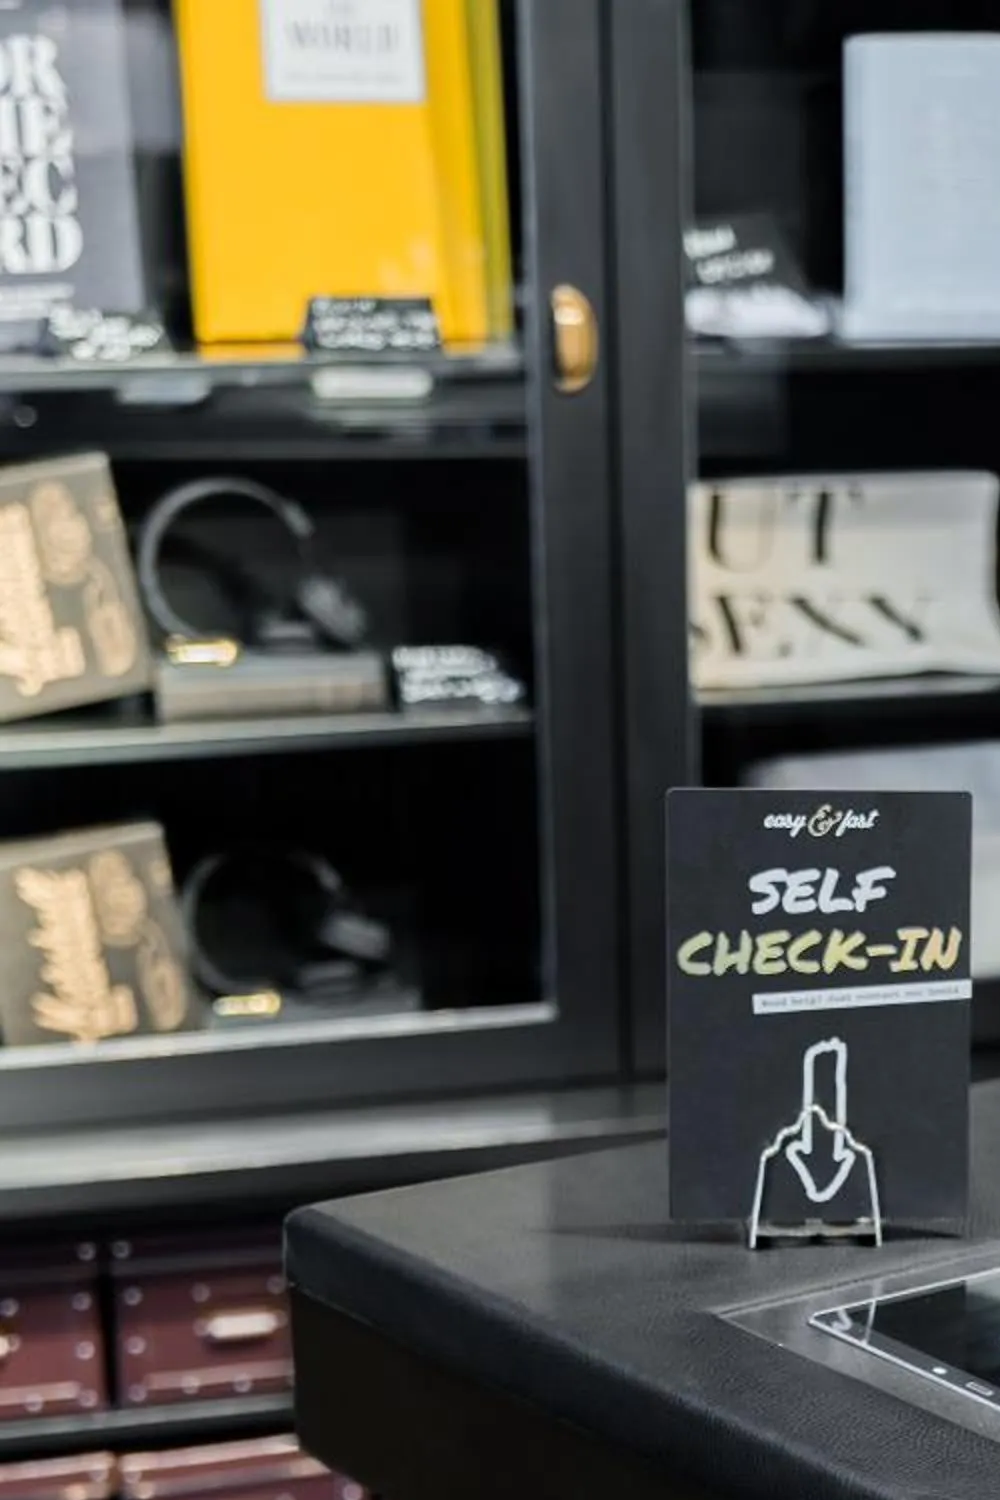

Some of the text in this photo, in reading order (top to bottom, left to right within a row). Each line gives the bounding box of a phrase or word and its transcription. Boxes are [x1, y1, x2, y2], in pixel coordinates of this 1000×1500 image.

[763, 811, 808, 838] easy
[835, 808, 880, 838] fast
[748, 866, 897, 915] SELF
[677, 927, 962, 977] CHECK-IN
